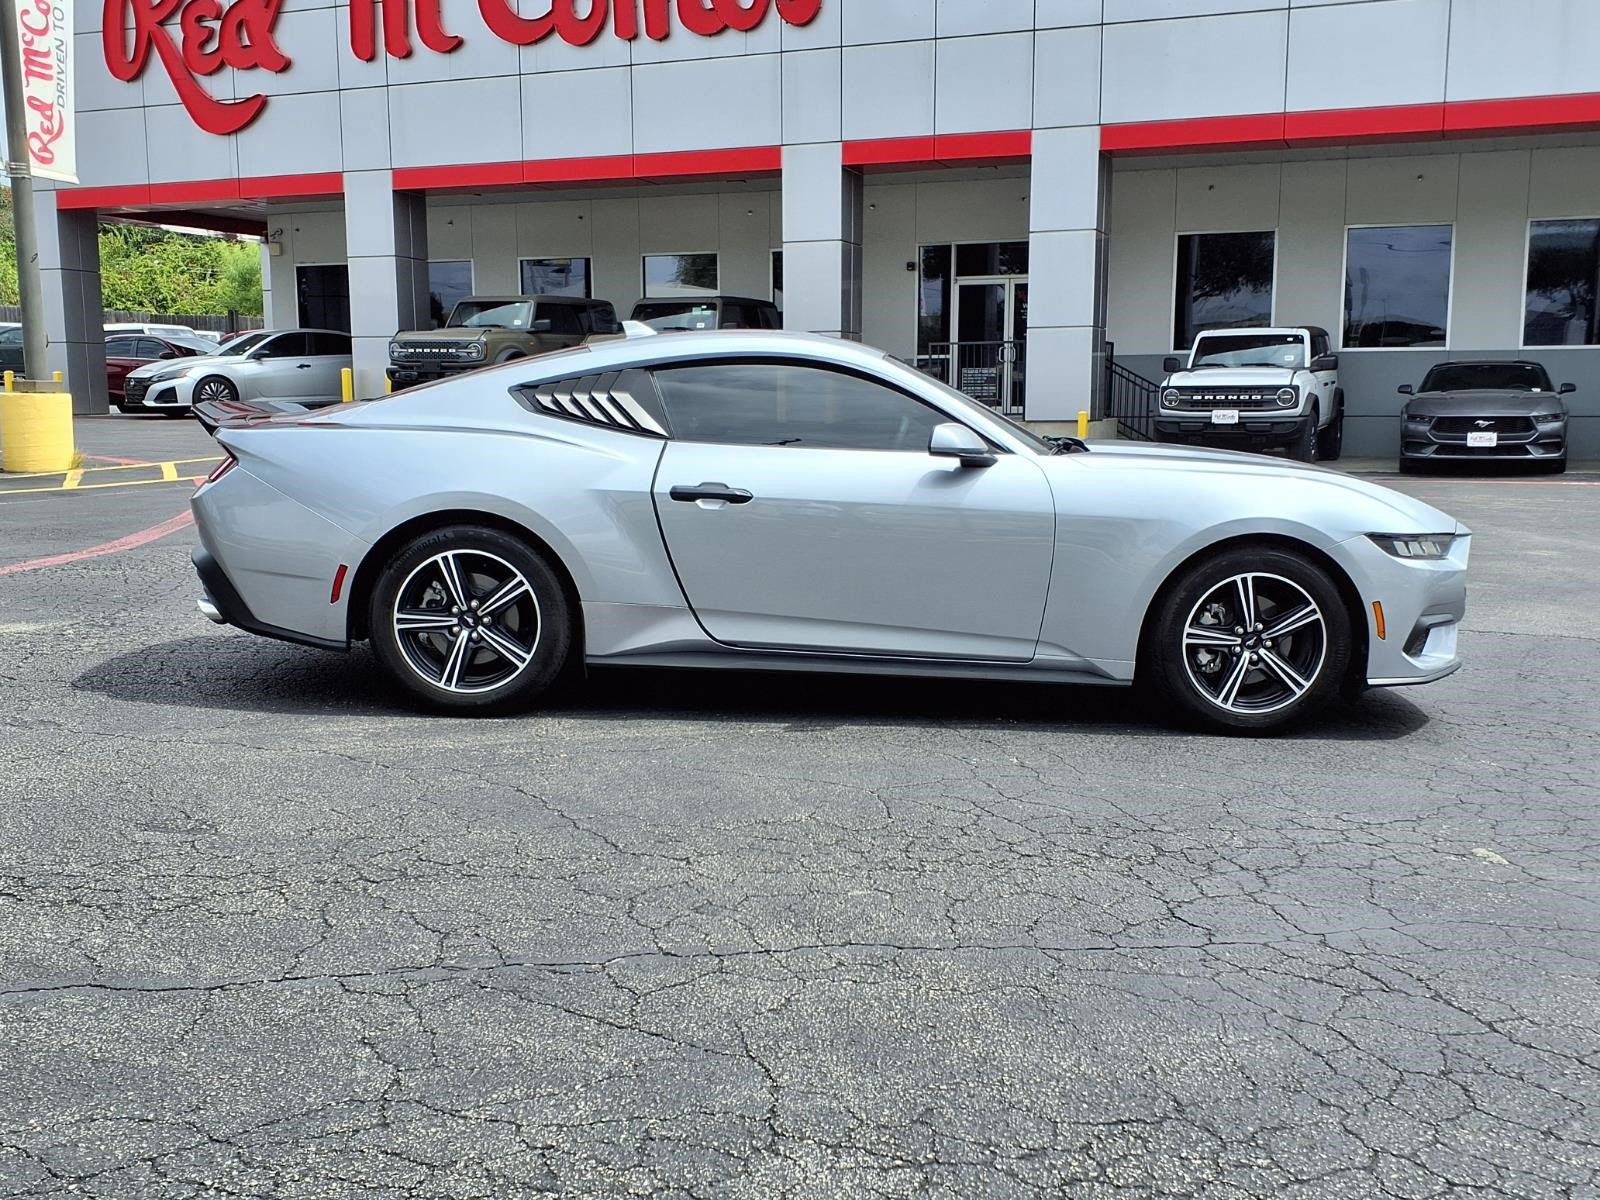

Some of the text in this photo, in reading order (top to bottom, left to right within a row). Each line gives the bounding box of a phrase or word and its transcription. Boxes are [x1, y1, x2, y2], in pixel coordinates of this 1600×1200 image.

[52, 7, 66, 109] DRIVEN TO
[28, 95, 65, 165] Red
